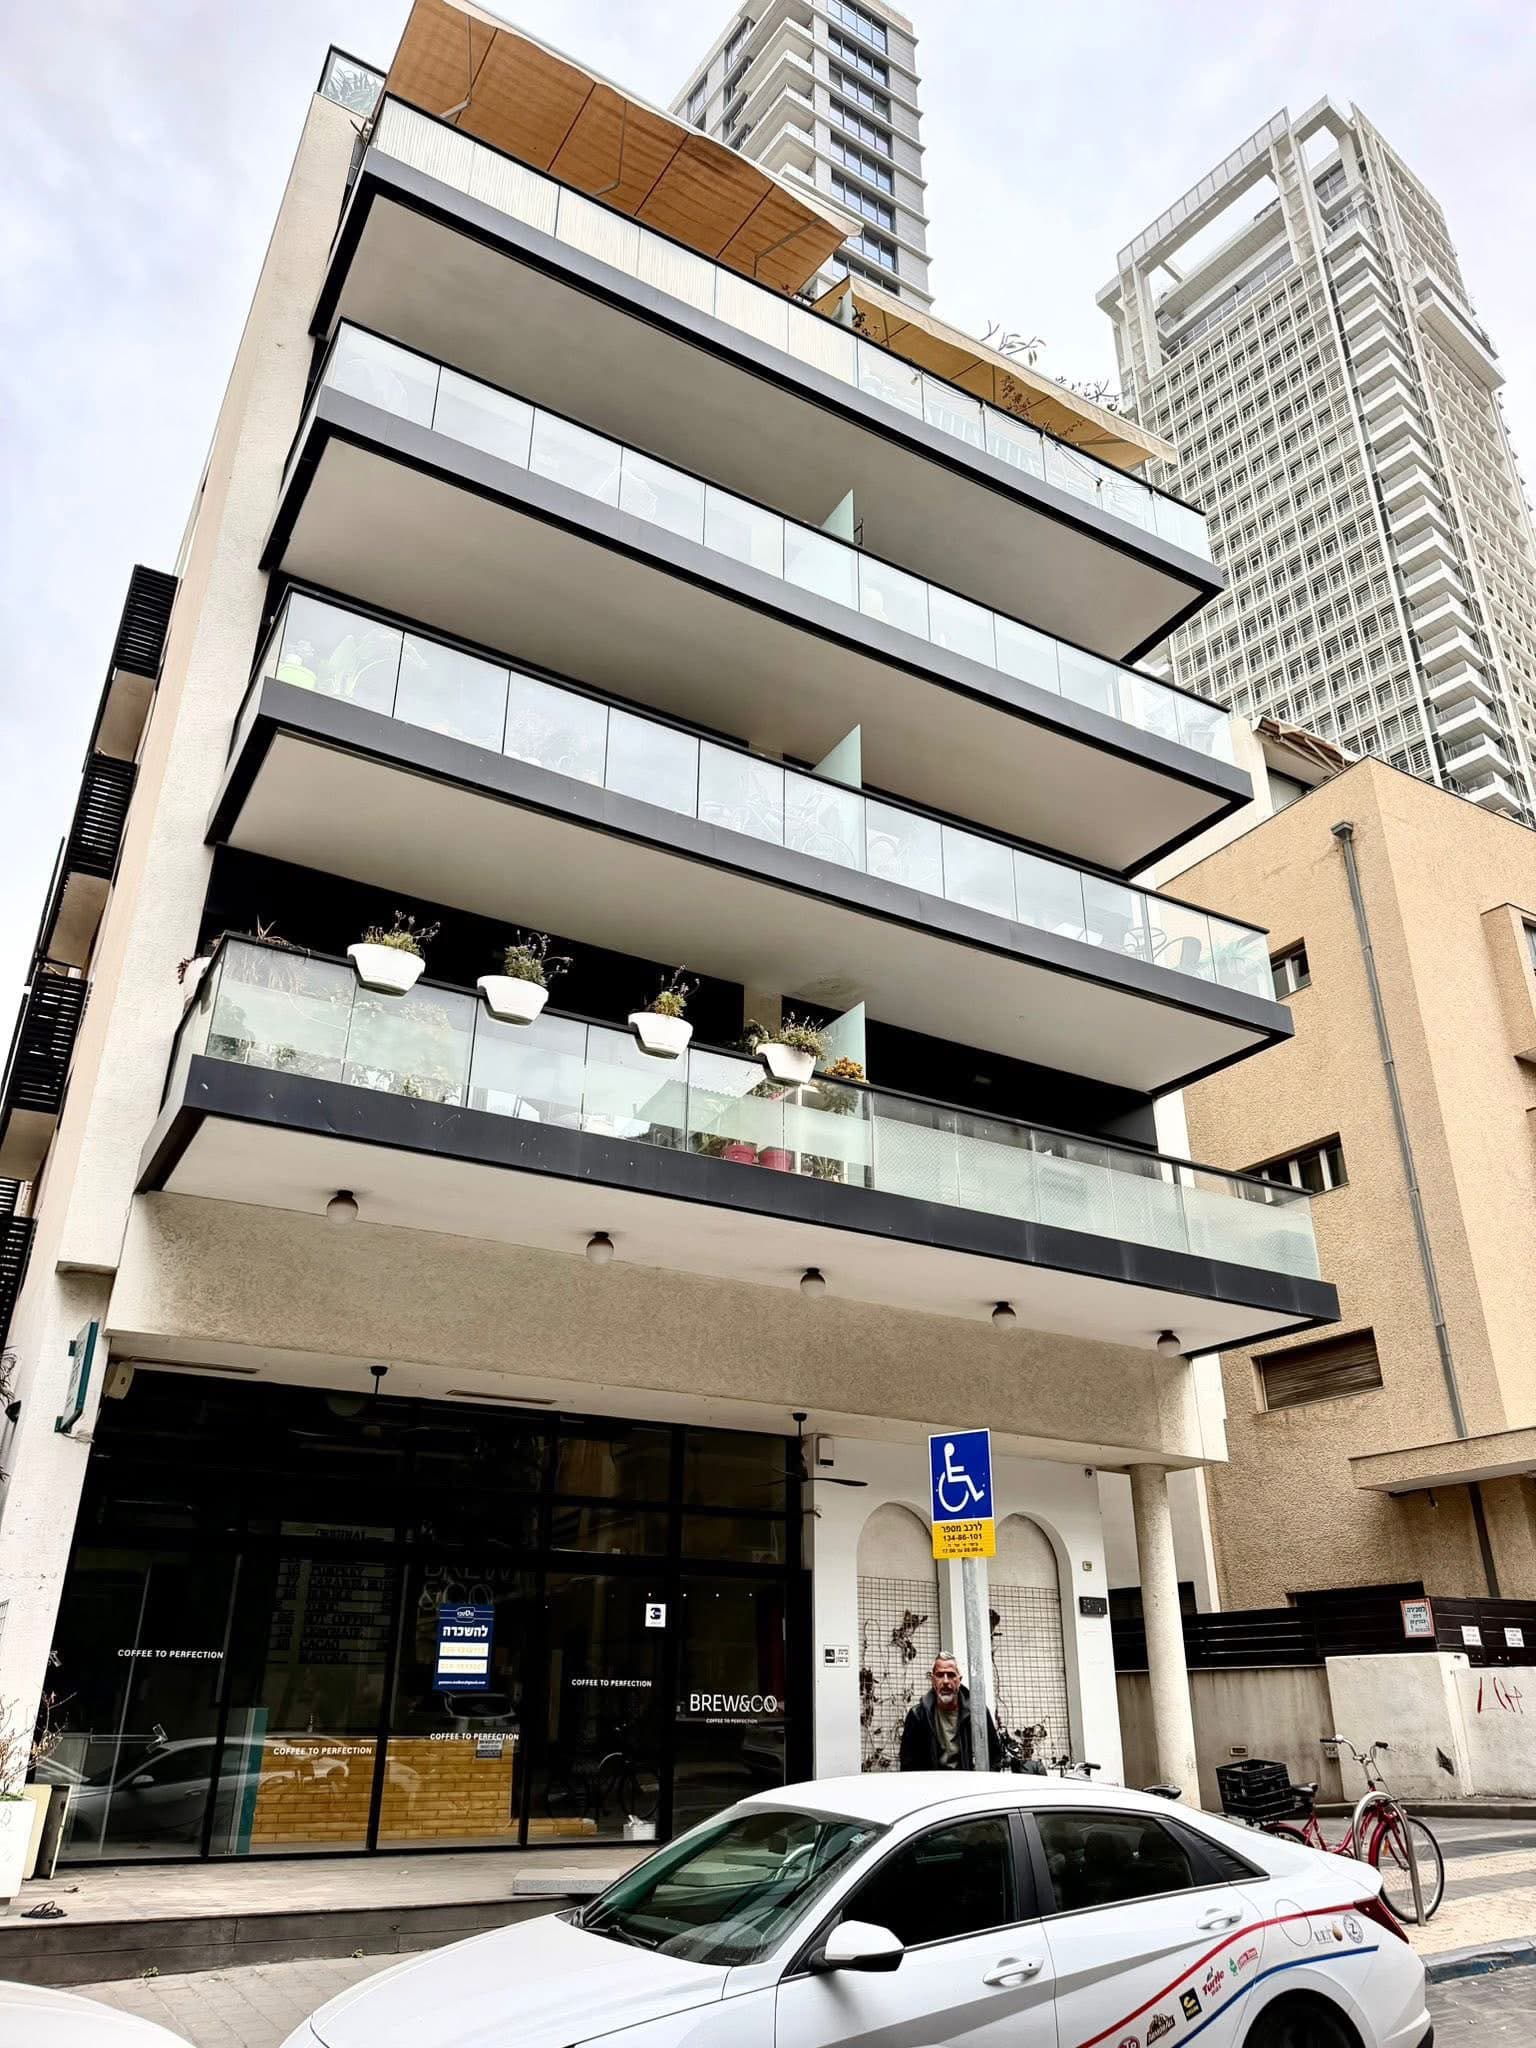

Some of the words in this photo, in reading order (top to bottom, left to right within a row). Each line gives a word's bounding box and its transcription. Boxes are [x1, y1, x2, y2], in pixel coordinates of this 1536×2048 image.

[941, 1525, 962, 1533] מספר
[964, 1520, 983, 1532] לרכב
[443, 1625, 489, 1638] להשכרה
[117, 1649, 153, 1658] COFFEE
[155, 1649, 167, 1658] TO
[169, 1650, 224, 1659] PERFECTION
[571, 1678, 598, 1687] COFFEE
[600, 1679, 609, 1687] TO
[610, 1679, 652, 1688] PERFECTION
[473, 1733, 519, 1741] PERFECTION
[273, 1746, 306, 1755] COFFEE
[308, 1747, 319, 1755] TO
[321, 1746, 372, 1755] PERFECTION
[1202, 1970, 1225, 1996] Turtle
